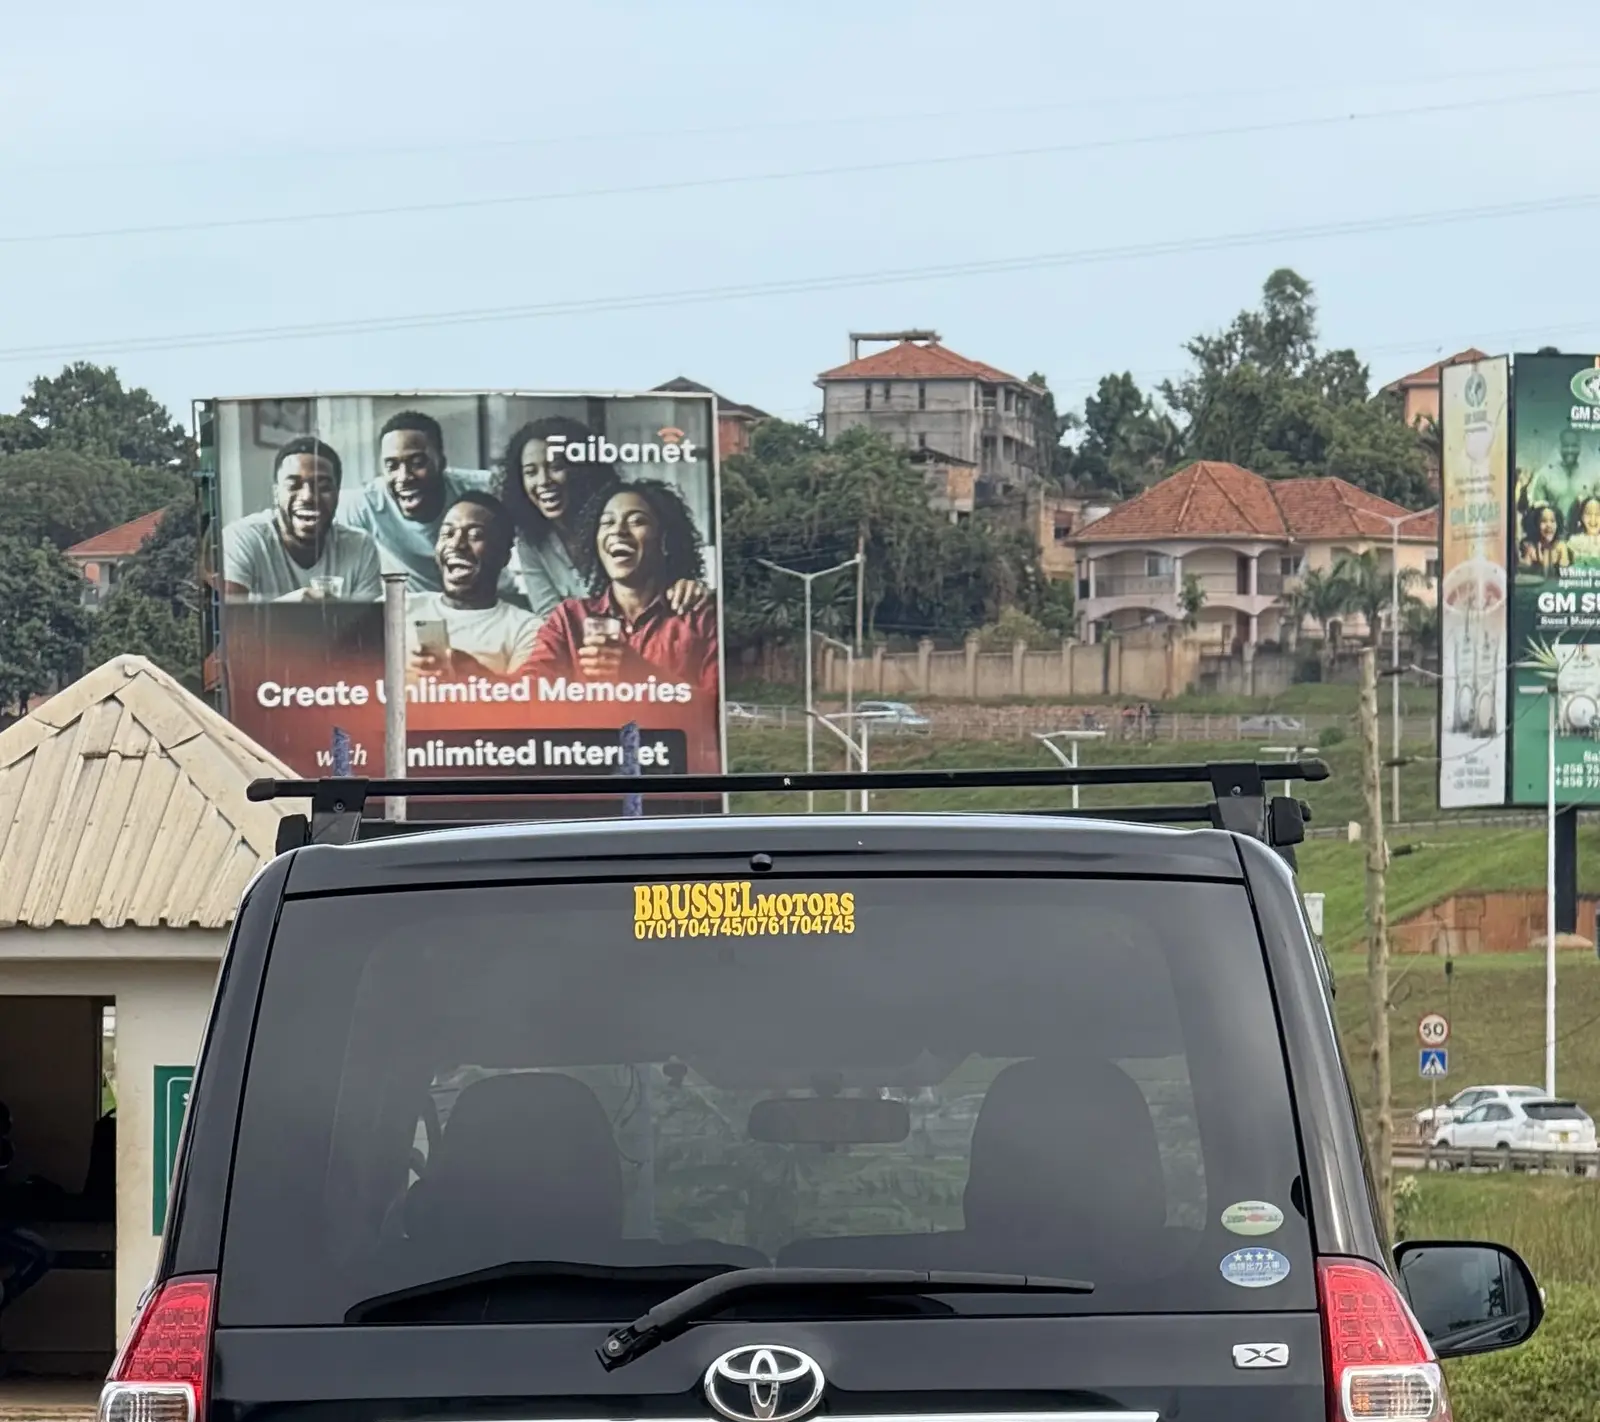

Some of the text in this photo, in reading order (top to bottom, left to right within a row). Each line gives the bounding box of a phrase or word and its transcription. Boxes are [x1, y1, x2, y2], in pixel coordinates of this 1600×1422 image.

[546, 435, 697, 463] Faibanet
[1538, 592, 1600, 613] GM S
[257, 681, 369, 707] Create
[538, 675, 692, 704] Memories
[408, 739, 536, 767] nlimited
[634, 881, 855, 921] BRUSSEL MOTORS
[634, 915, 855, 940] 0701704745/0761704745
[1422, 1022, 1445, 1038] 50
